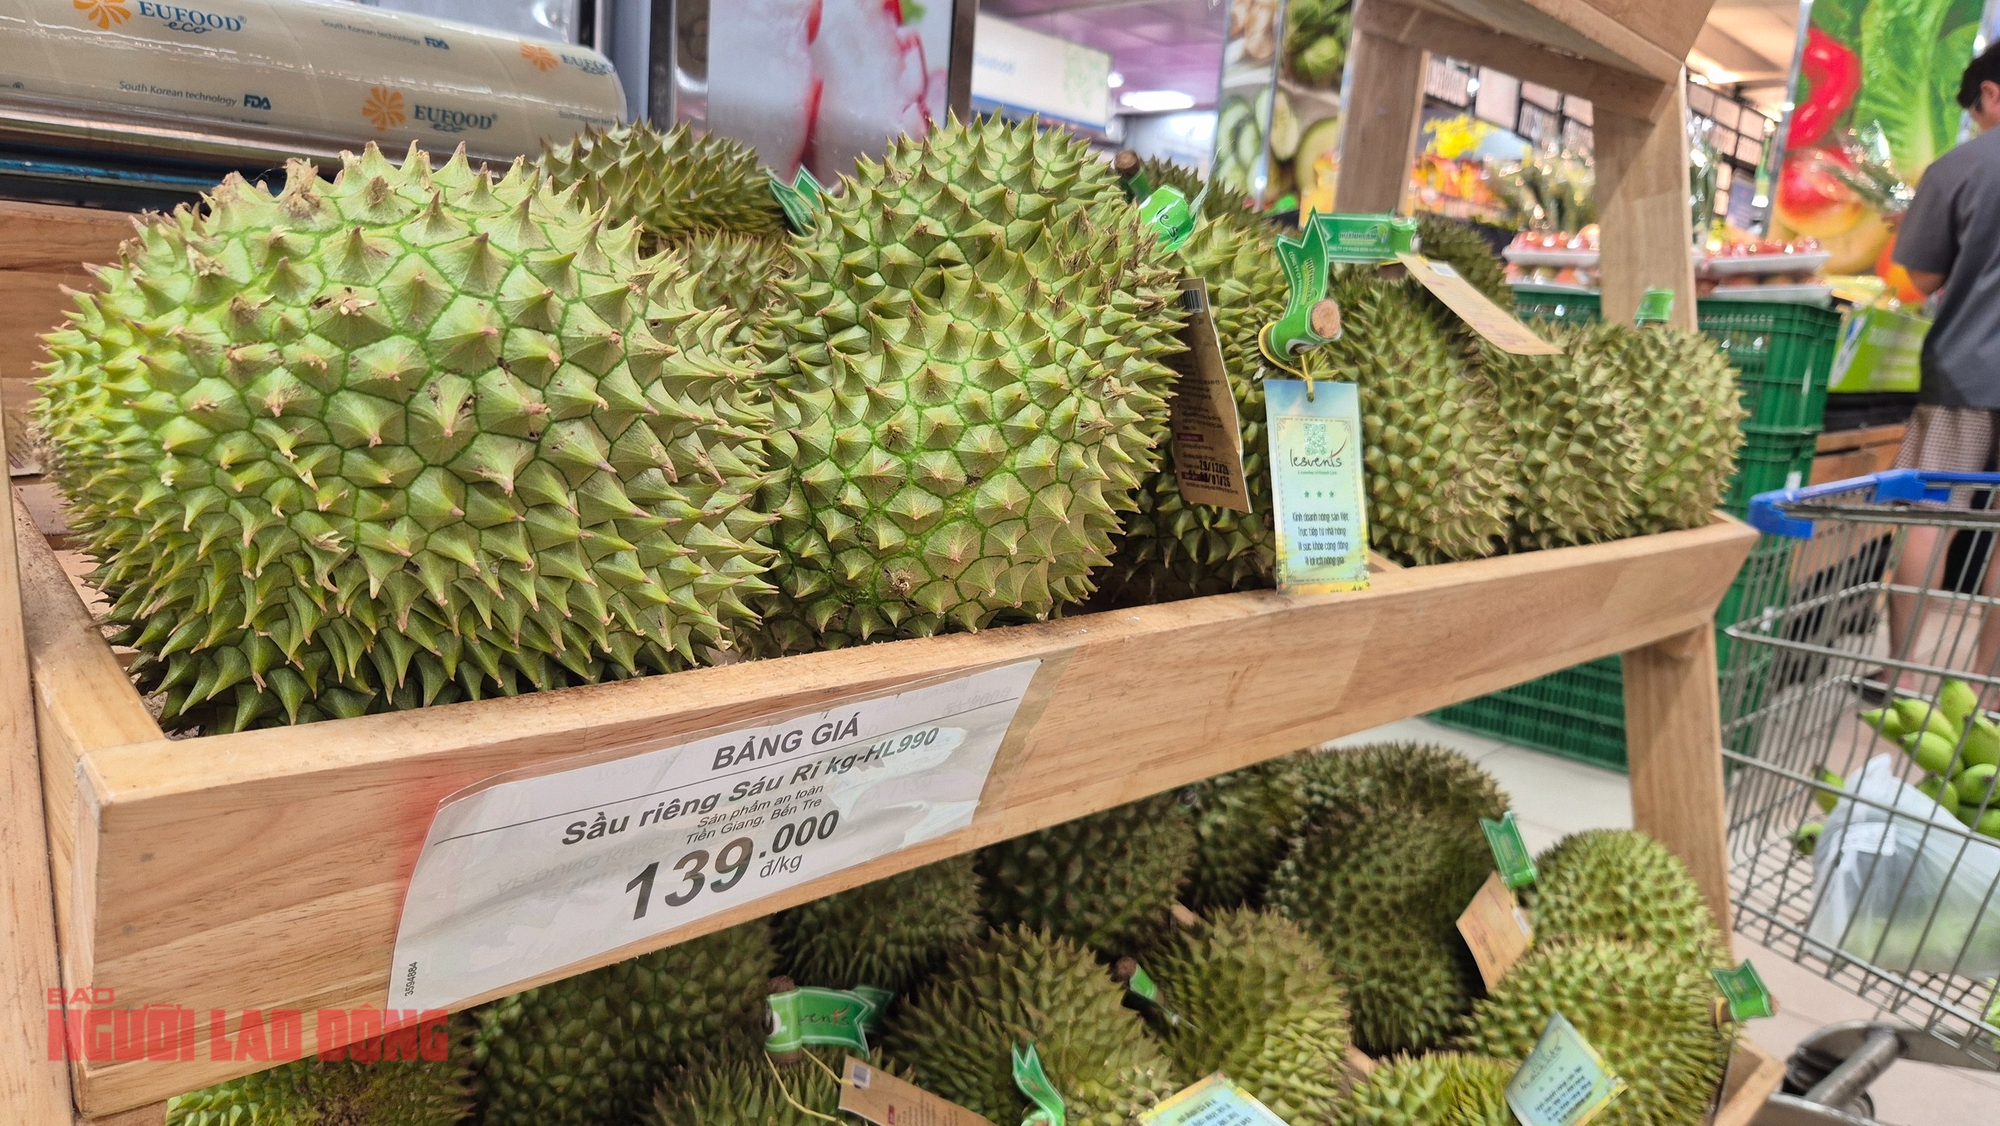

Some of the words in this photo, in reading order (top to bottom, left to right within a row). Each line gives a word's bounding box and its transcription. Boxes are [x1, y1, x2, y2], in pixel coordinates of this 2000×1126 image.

[424, 36, 450, 51] FDA
[119, 80, 148, 93] South
[150, 85, 183, 98] Korean
[185, 90, 237, 107] technology
[243, 94, 272, 110] FDA
[711, 730, 803, 771] BẢNG
[811, 711, 861, 746] GIÁ
[561, 812, 630, 846] Sầu
[638, 792, 722, 828] riêng
[728, 775, 785, 802] Sáu
[790, 760, 821, 785] Ri
[824, 727, 940, 776] kg-HL990
[697, 813, 727, 828] Sản
[730, 801, 771, 822] phẩm
[772, 794, 792, 807] an
[795, 783, 824, 801] toàn
[686, 827, 717, 845] Tiền
[720, 815, 765, 835] Giang,
[770, 804, 798, 821] Bến
[802, 797, 823, 812] Tre
[759, 853, 803, 879] đ/kg
[404, 961, 418, 997] 3594884
